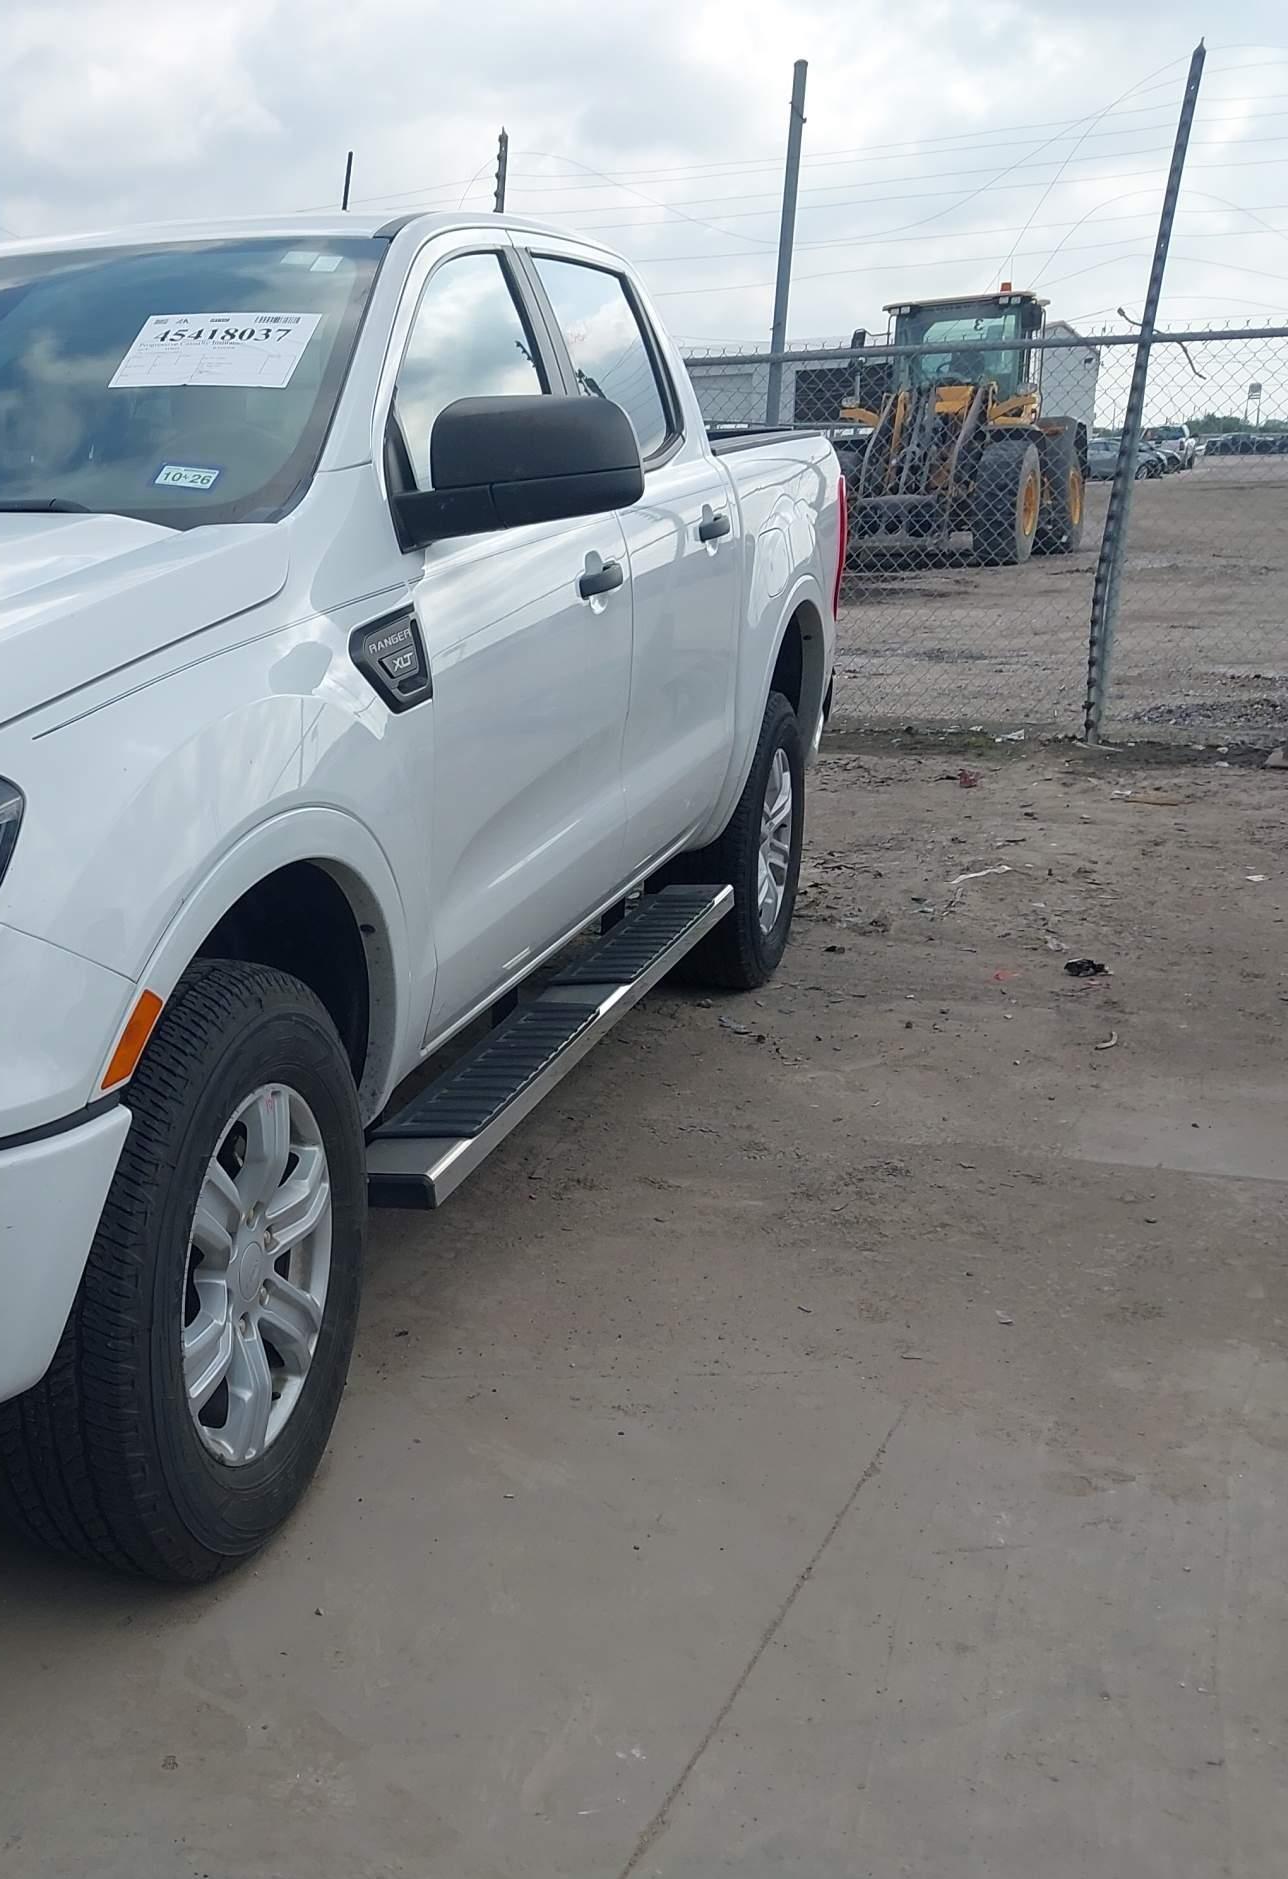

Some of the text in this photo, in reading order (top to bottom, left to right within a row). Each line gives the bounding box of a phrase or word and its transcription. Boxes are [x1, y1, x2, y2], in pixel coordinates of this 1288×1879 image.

[153, 327, 292, 342] 45418037
[163, 471, 212, 485] 10 26
[368, 628, 411, 655] RANGER
[392, 652, 413, 672] XLT
